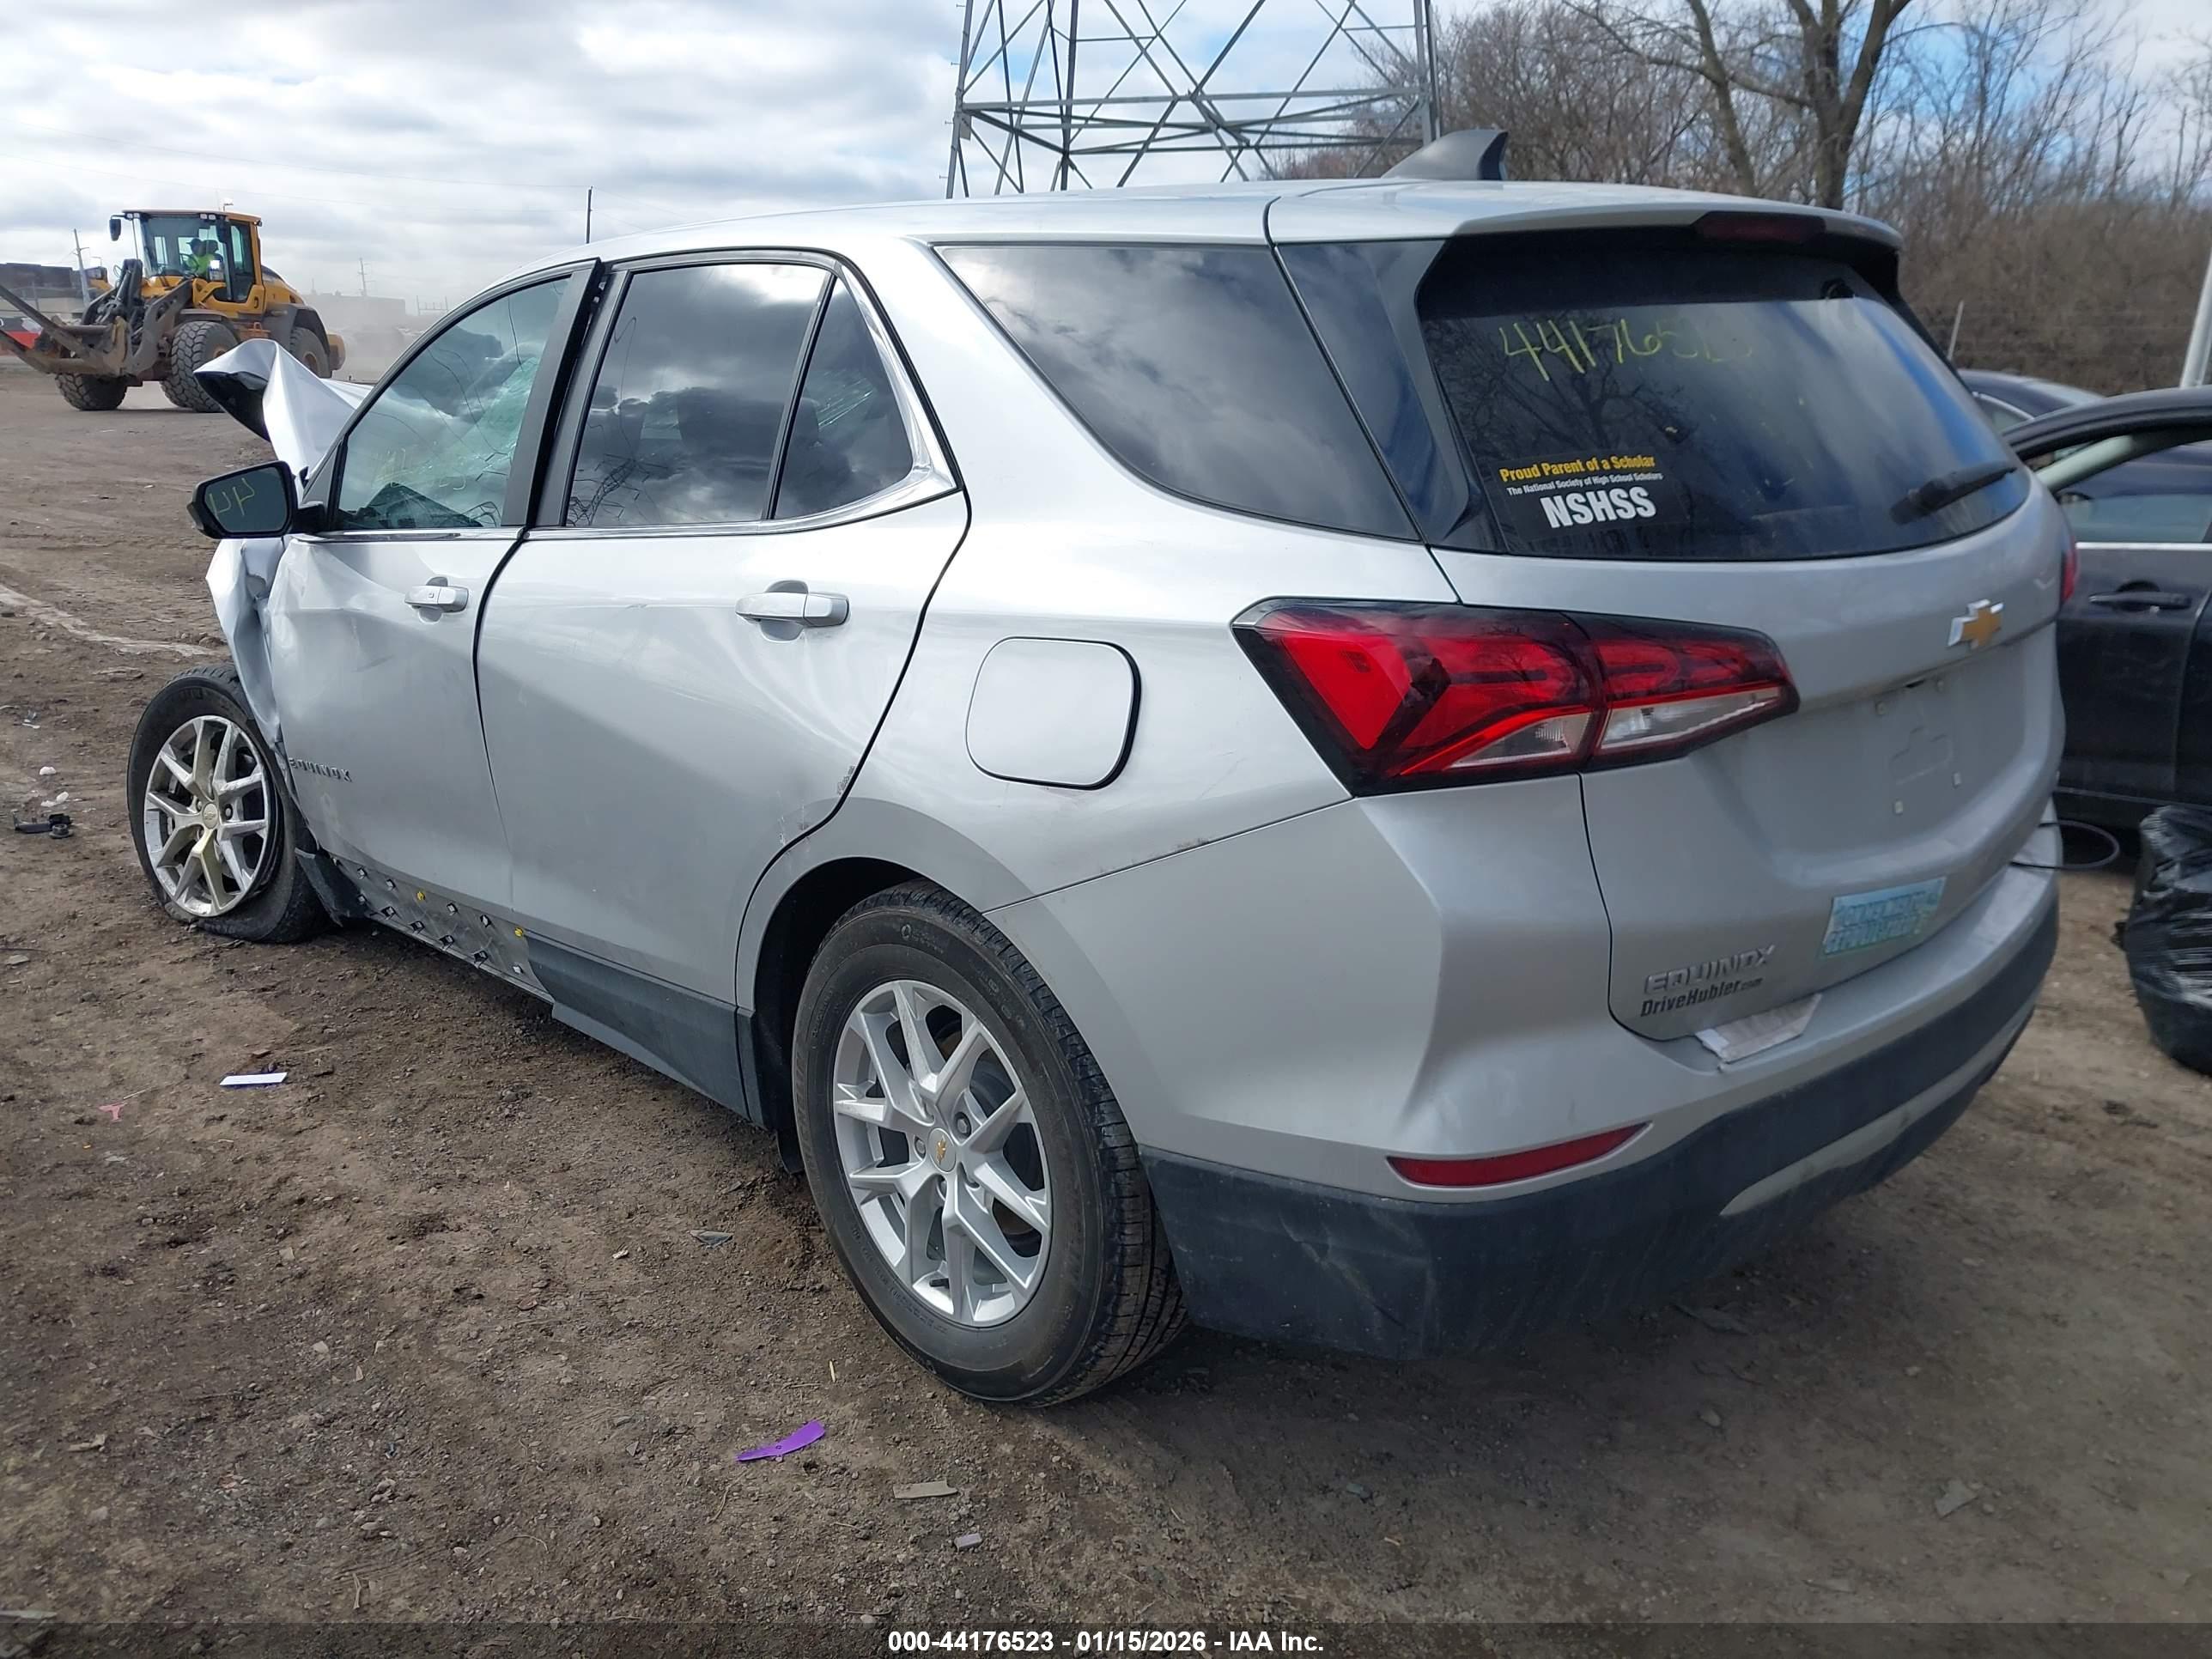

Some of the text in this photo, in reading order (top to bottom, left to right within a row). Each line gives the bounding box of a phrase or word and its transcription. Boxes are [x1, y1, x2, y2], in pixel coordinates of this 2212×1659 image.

[1499, 454, 1656, 483] Proud Parent of a Scholar
[1506, 471, 1664, 496] The National Society of High School Scholars
[1540, 486, 1657, 530] NSHSS
[1644, 944, 1776, 994] EQUINOX
